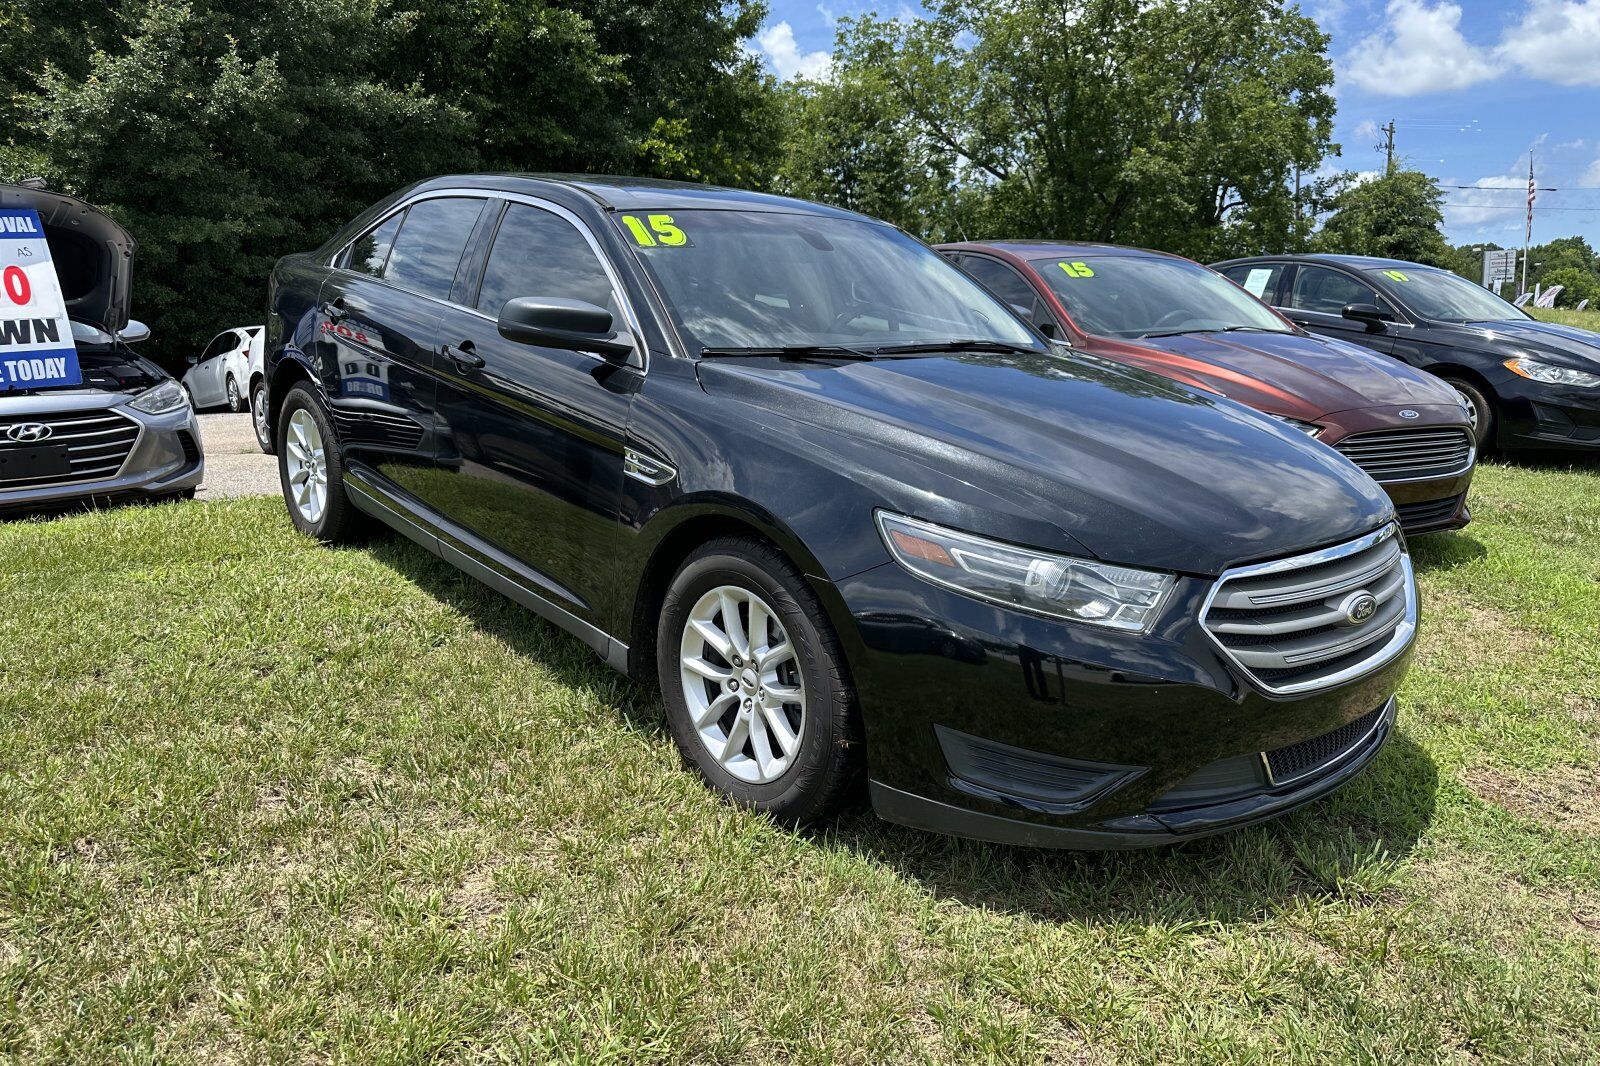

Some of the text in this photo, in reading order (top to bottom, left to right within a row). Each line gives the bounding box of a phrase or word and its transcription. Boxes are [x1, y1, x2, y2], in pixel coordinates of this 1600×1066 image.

[622, 214, 687, 247] 15
[17, 246, 33, 257] AS
[1058, 262, 1095, 278] 15
[4, 357, 66, 382] TODAY
